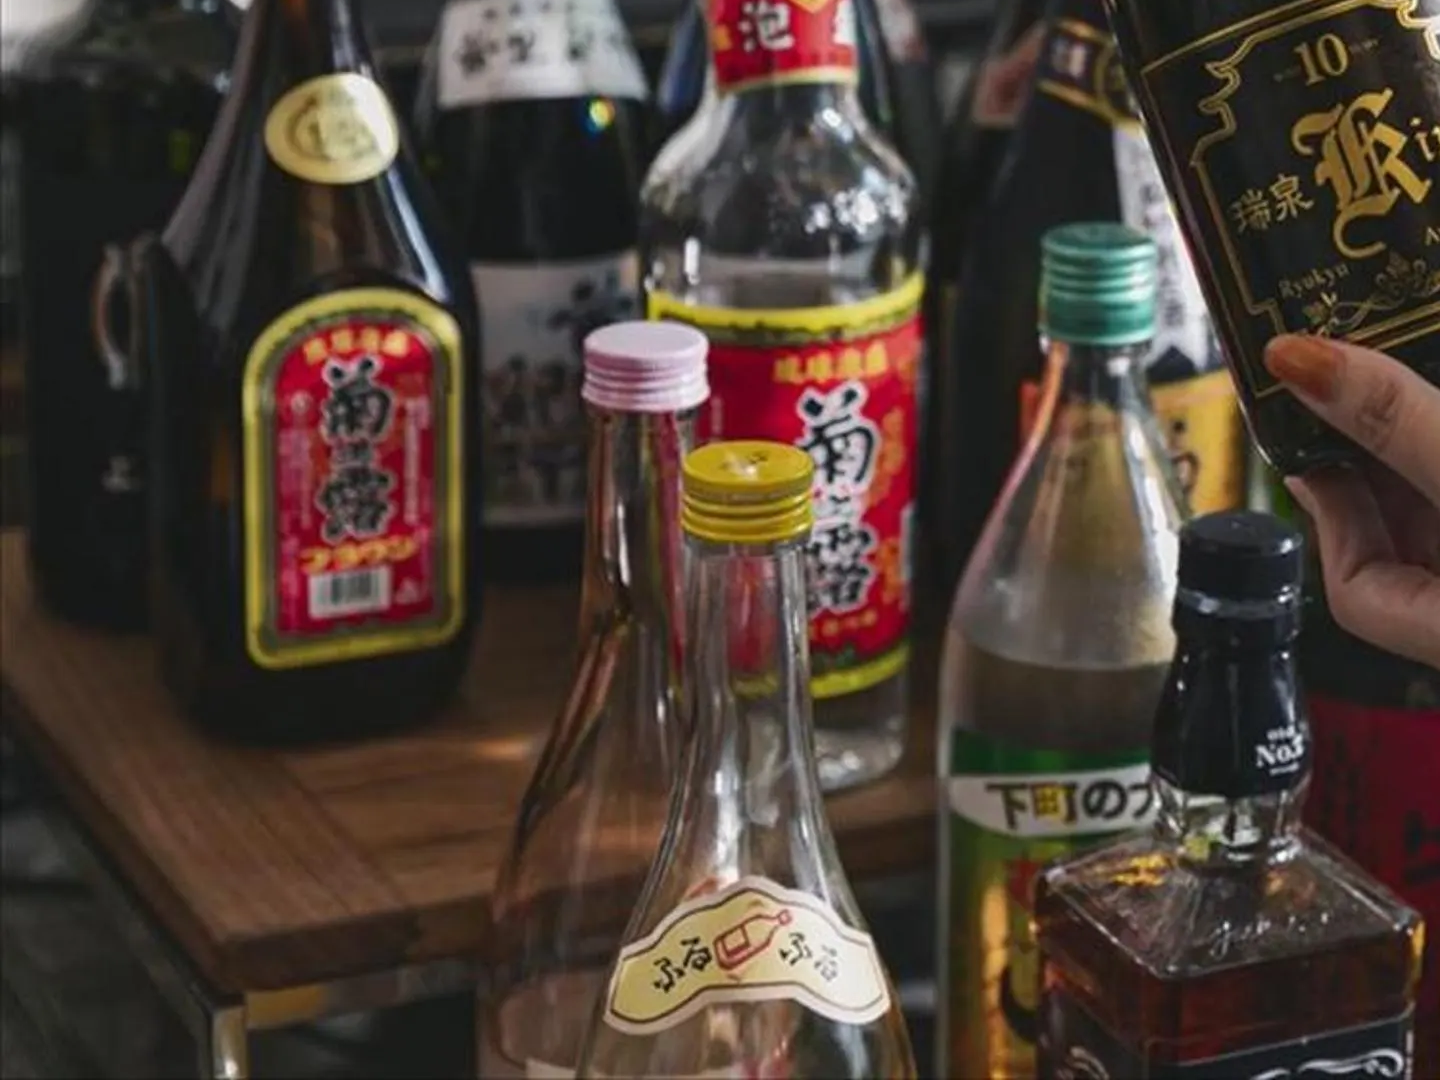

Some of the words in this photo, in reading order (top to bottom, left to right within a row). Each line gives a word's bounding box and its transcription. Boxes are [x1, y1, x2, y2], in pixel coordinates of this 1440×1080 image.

[1293, 32, 1349, 86] 10
[1227, 173, 1314, 233] 瑞泉
[1278, 263, 1350, 299] Ryukyu
